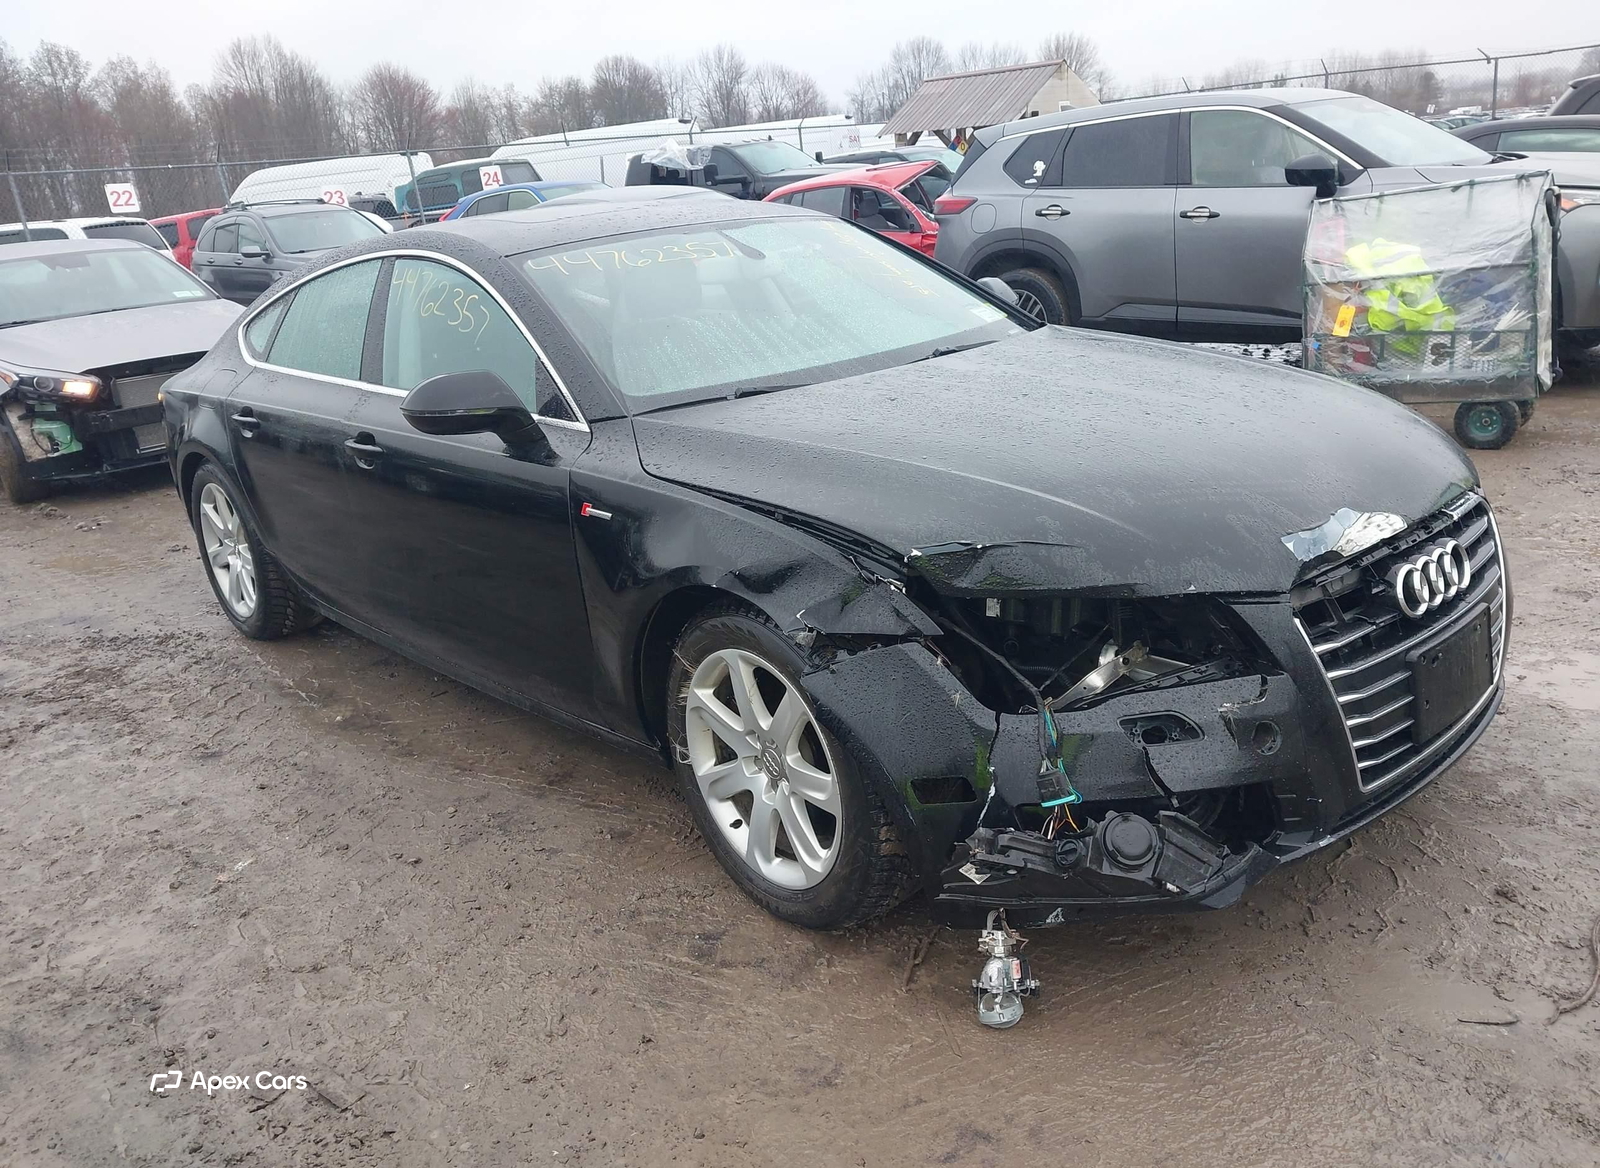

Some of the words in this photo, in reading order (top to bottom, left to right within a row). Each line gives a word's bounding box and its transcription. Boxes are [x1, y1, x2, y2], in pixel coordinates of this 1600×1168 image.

[482, 171, 501, 187] 24
[109, 190, 136, 207] 22
[323, 190, 346, 205] 23
[527, 241, 735, 276] 44762357
[391, 266, 490, 345] 44762357
